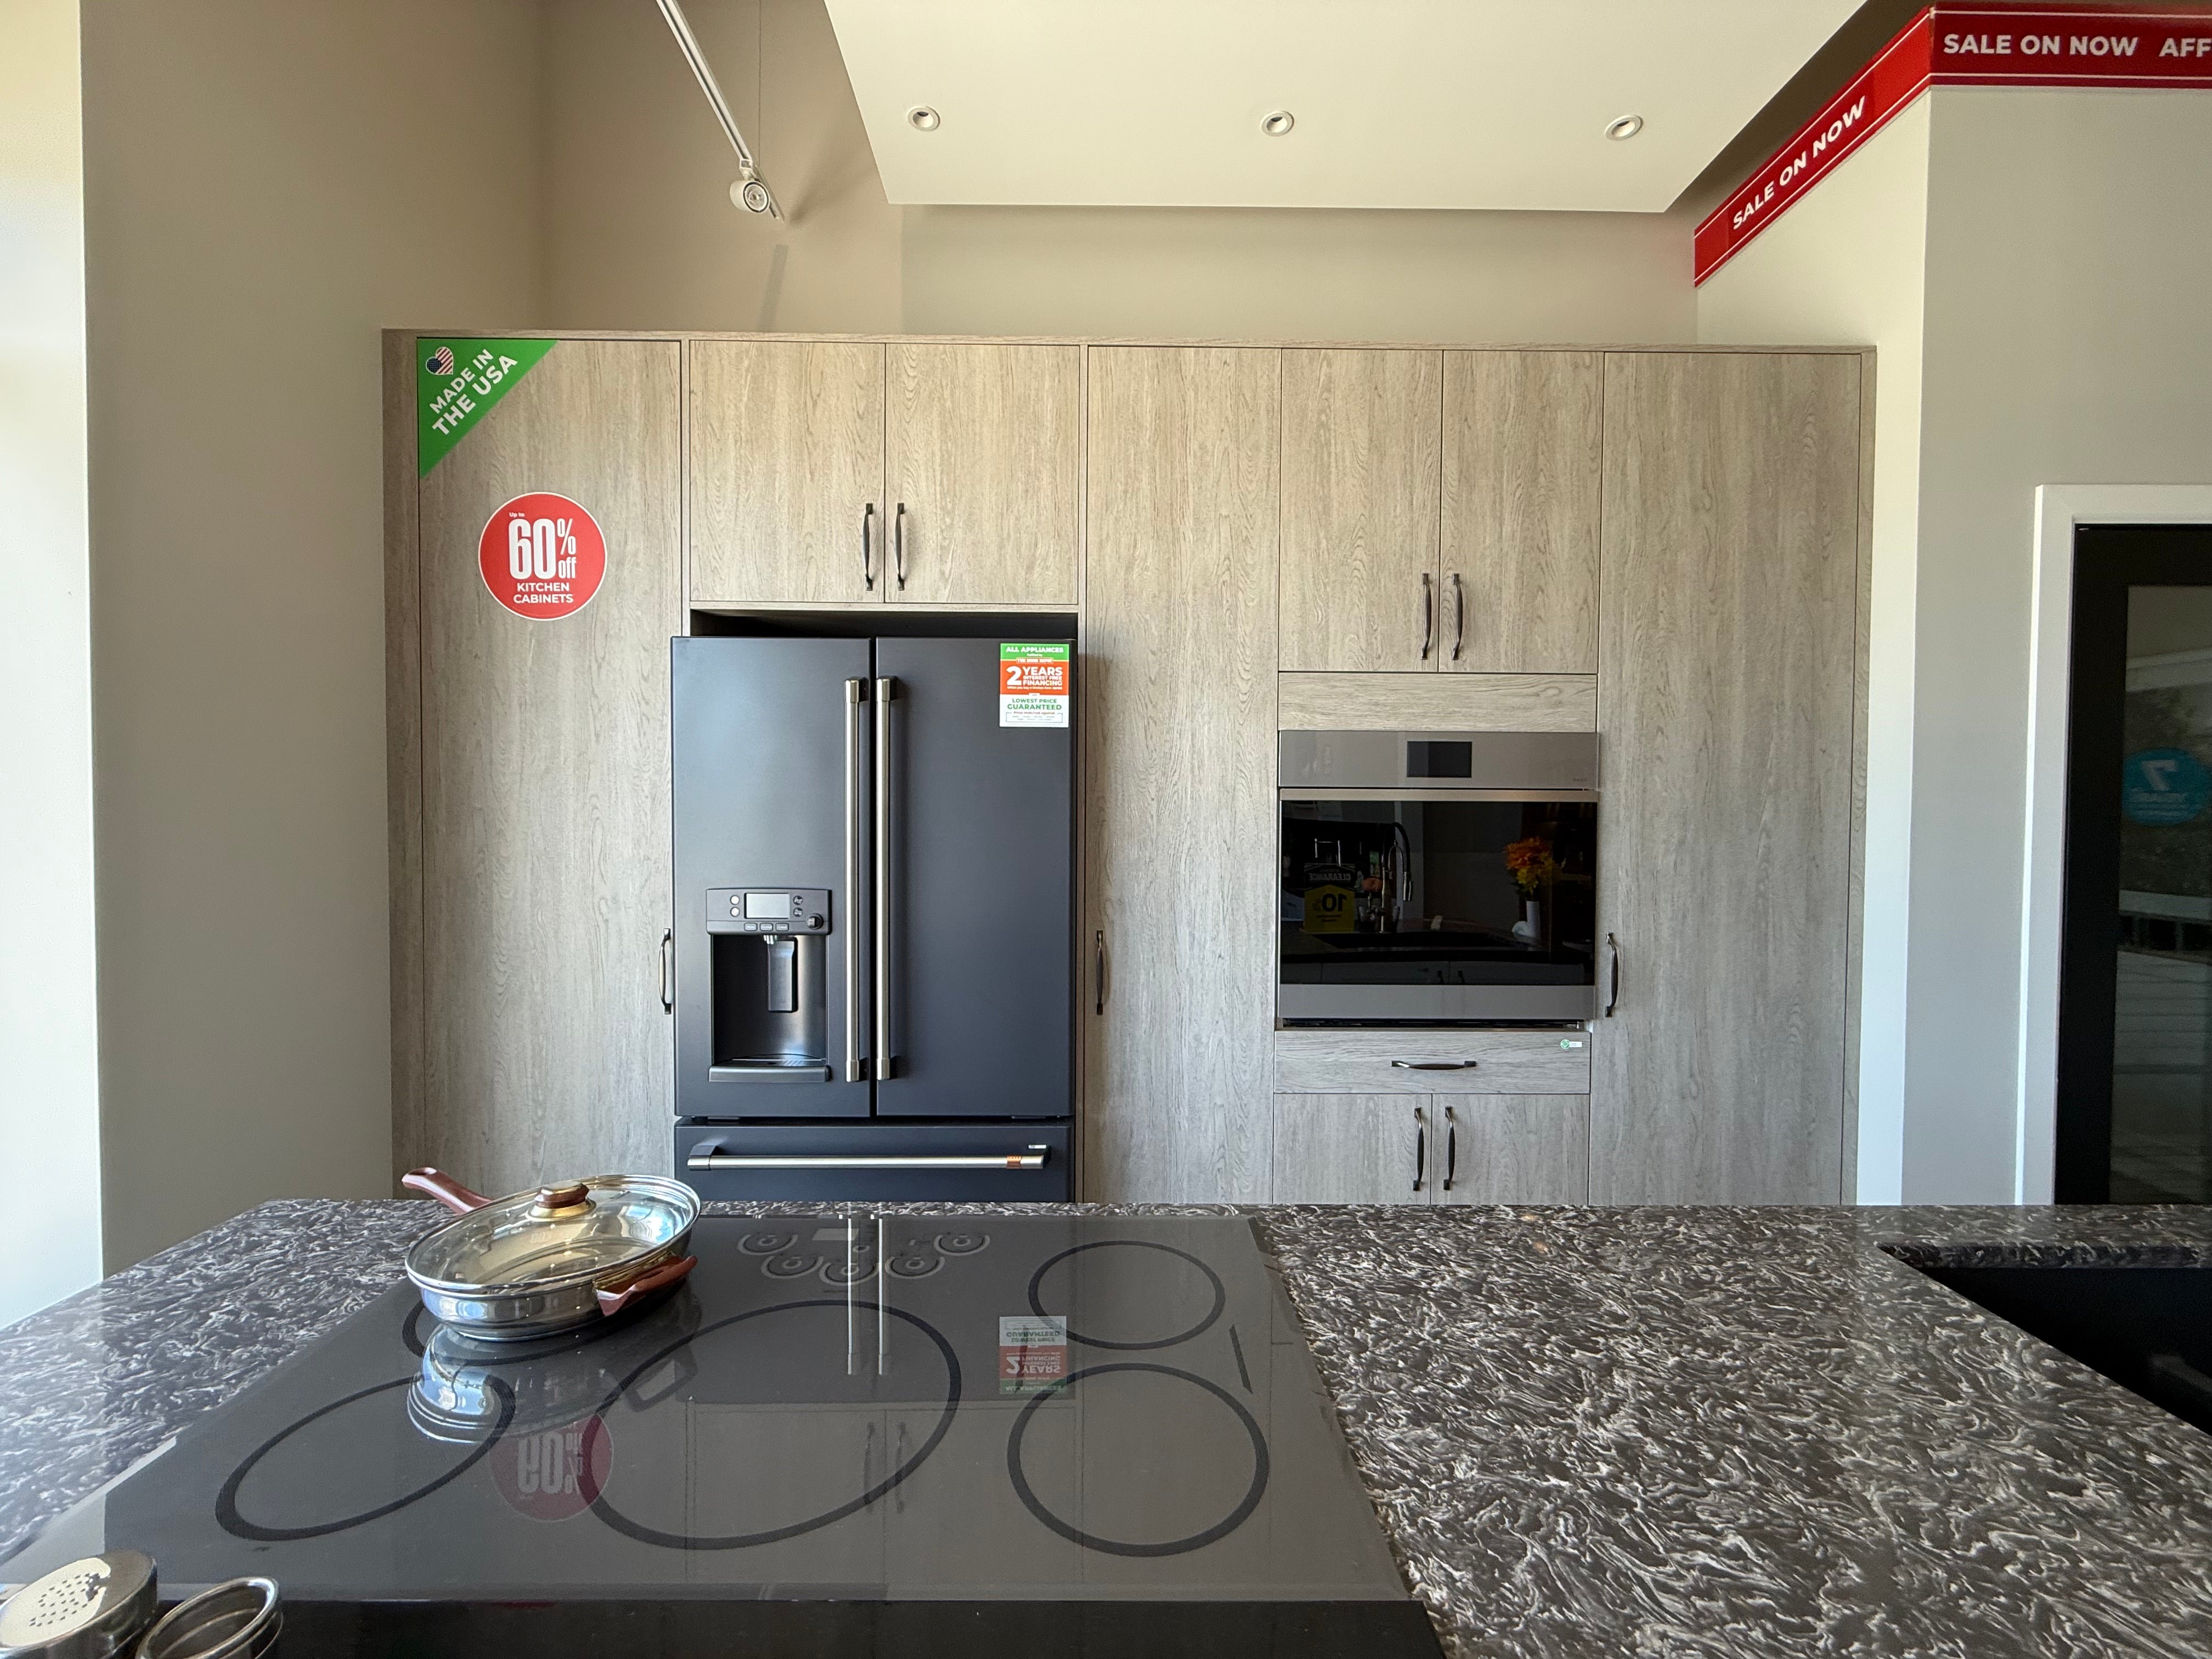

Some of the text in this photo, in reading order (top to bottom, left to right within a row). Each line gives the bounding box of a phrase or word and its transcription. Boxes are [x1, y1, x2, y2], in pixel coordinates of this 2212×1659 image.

[1944, 33, 2212, 58] SALE ON NOW AFF
[1733, 95, 1865, 230] SALE ON NOW
[430, 348, 494, 414] MADE IN
[432, 356, 518, 435] THE USA
[509, 518, 577, 579] 60%
[558, 556, 577, 579] off
[513, 594, 574, 603] CABINETS
[517, 582, 570, 592] KITCHEN
[1006, 665, 1022, 685] 2
[1022, 666, 1063, 675] YEARS
